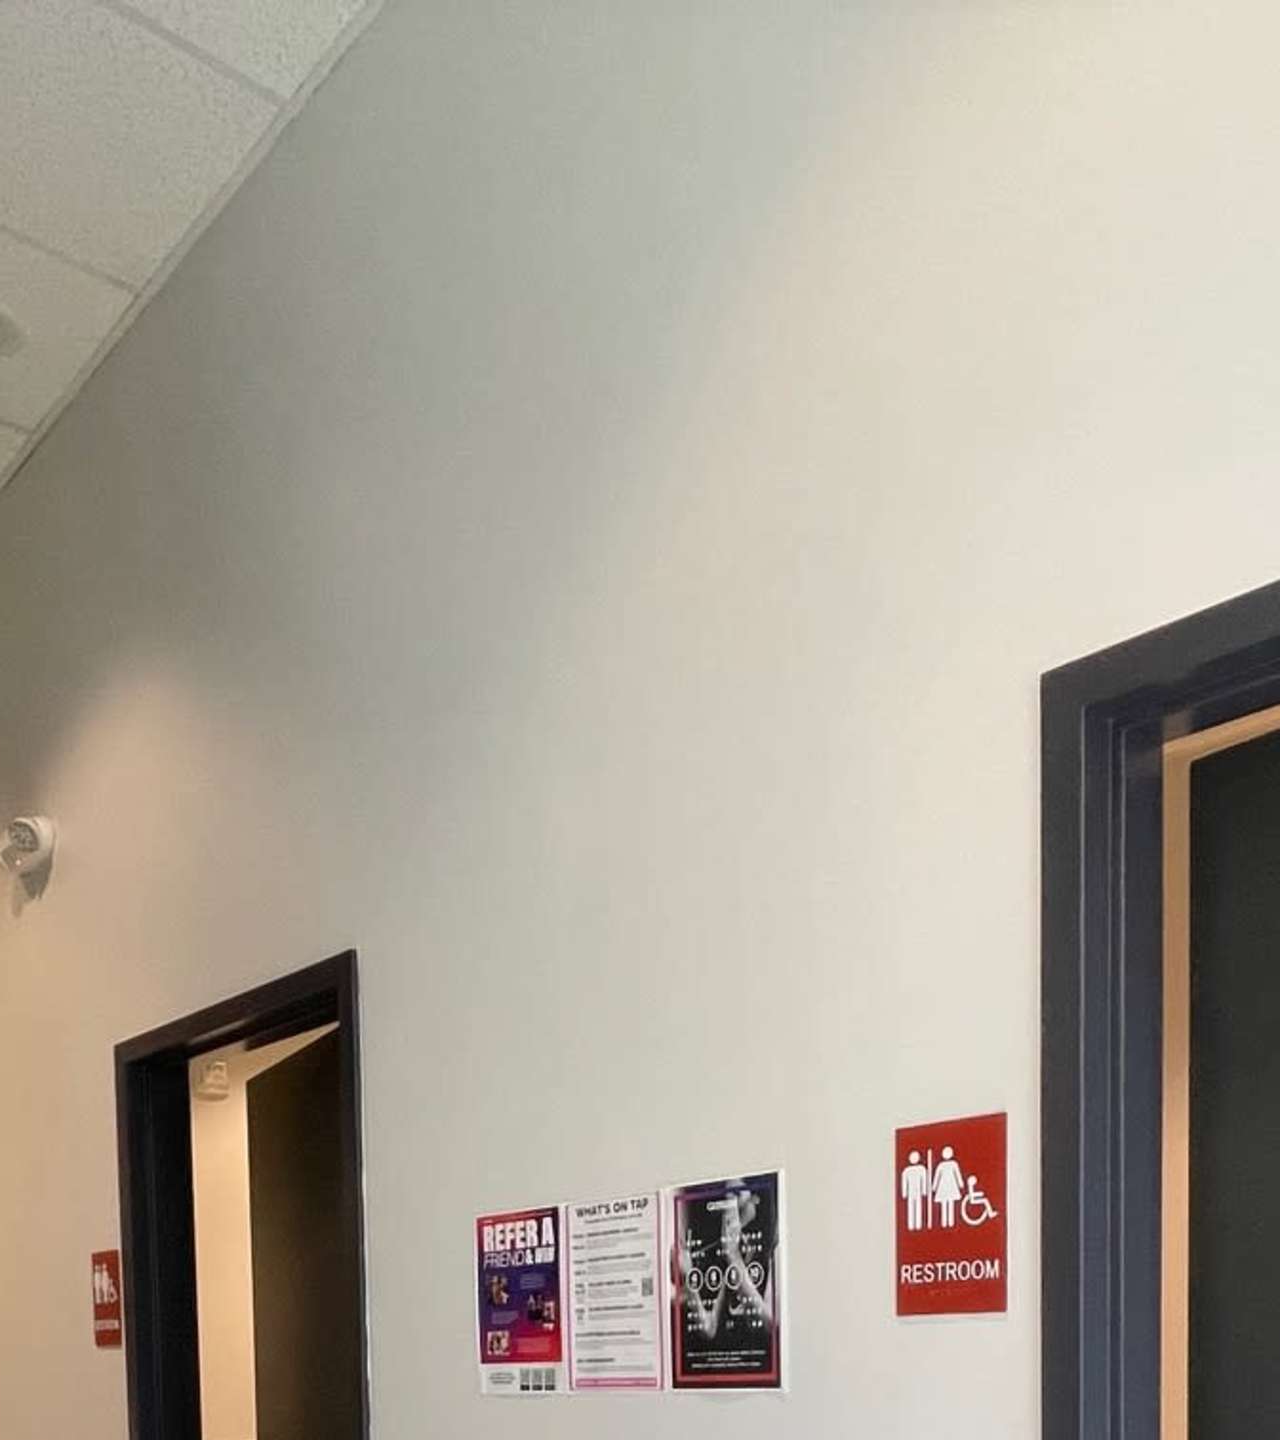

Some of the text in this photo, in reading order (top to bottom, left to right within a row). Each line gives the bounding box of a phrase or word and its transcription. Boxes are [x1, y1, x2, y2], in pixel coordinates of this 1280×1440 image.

[576, 1198, 648, 1218] WHAT'S ON TAP
[483, 1219, 540, 1250] REFER
[542, 1216, 555, 1246] A
[483, 1249, 525, 1269] FRIEND
[525, 1249, 534, 1265] &
[901, 1259, 1000, 1284] RESTROOM
